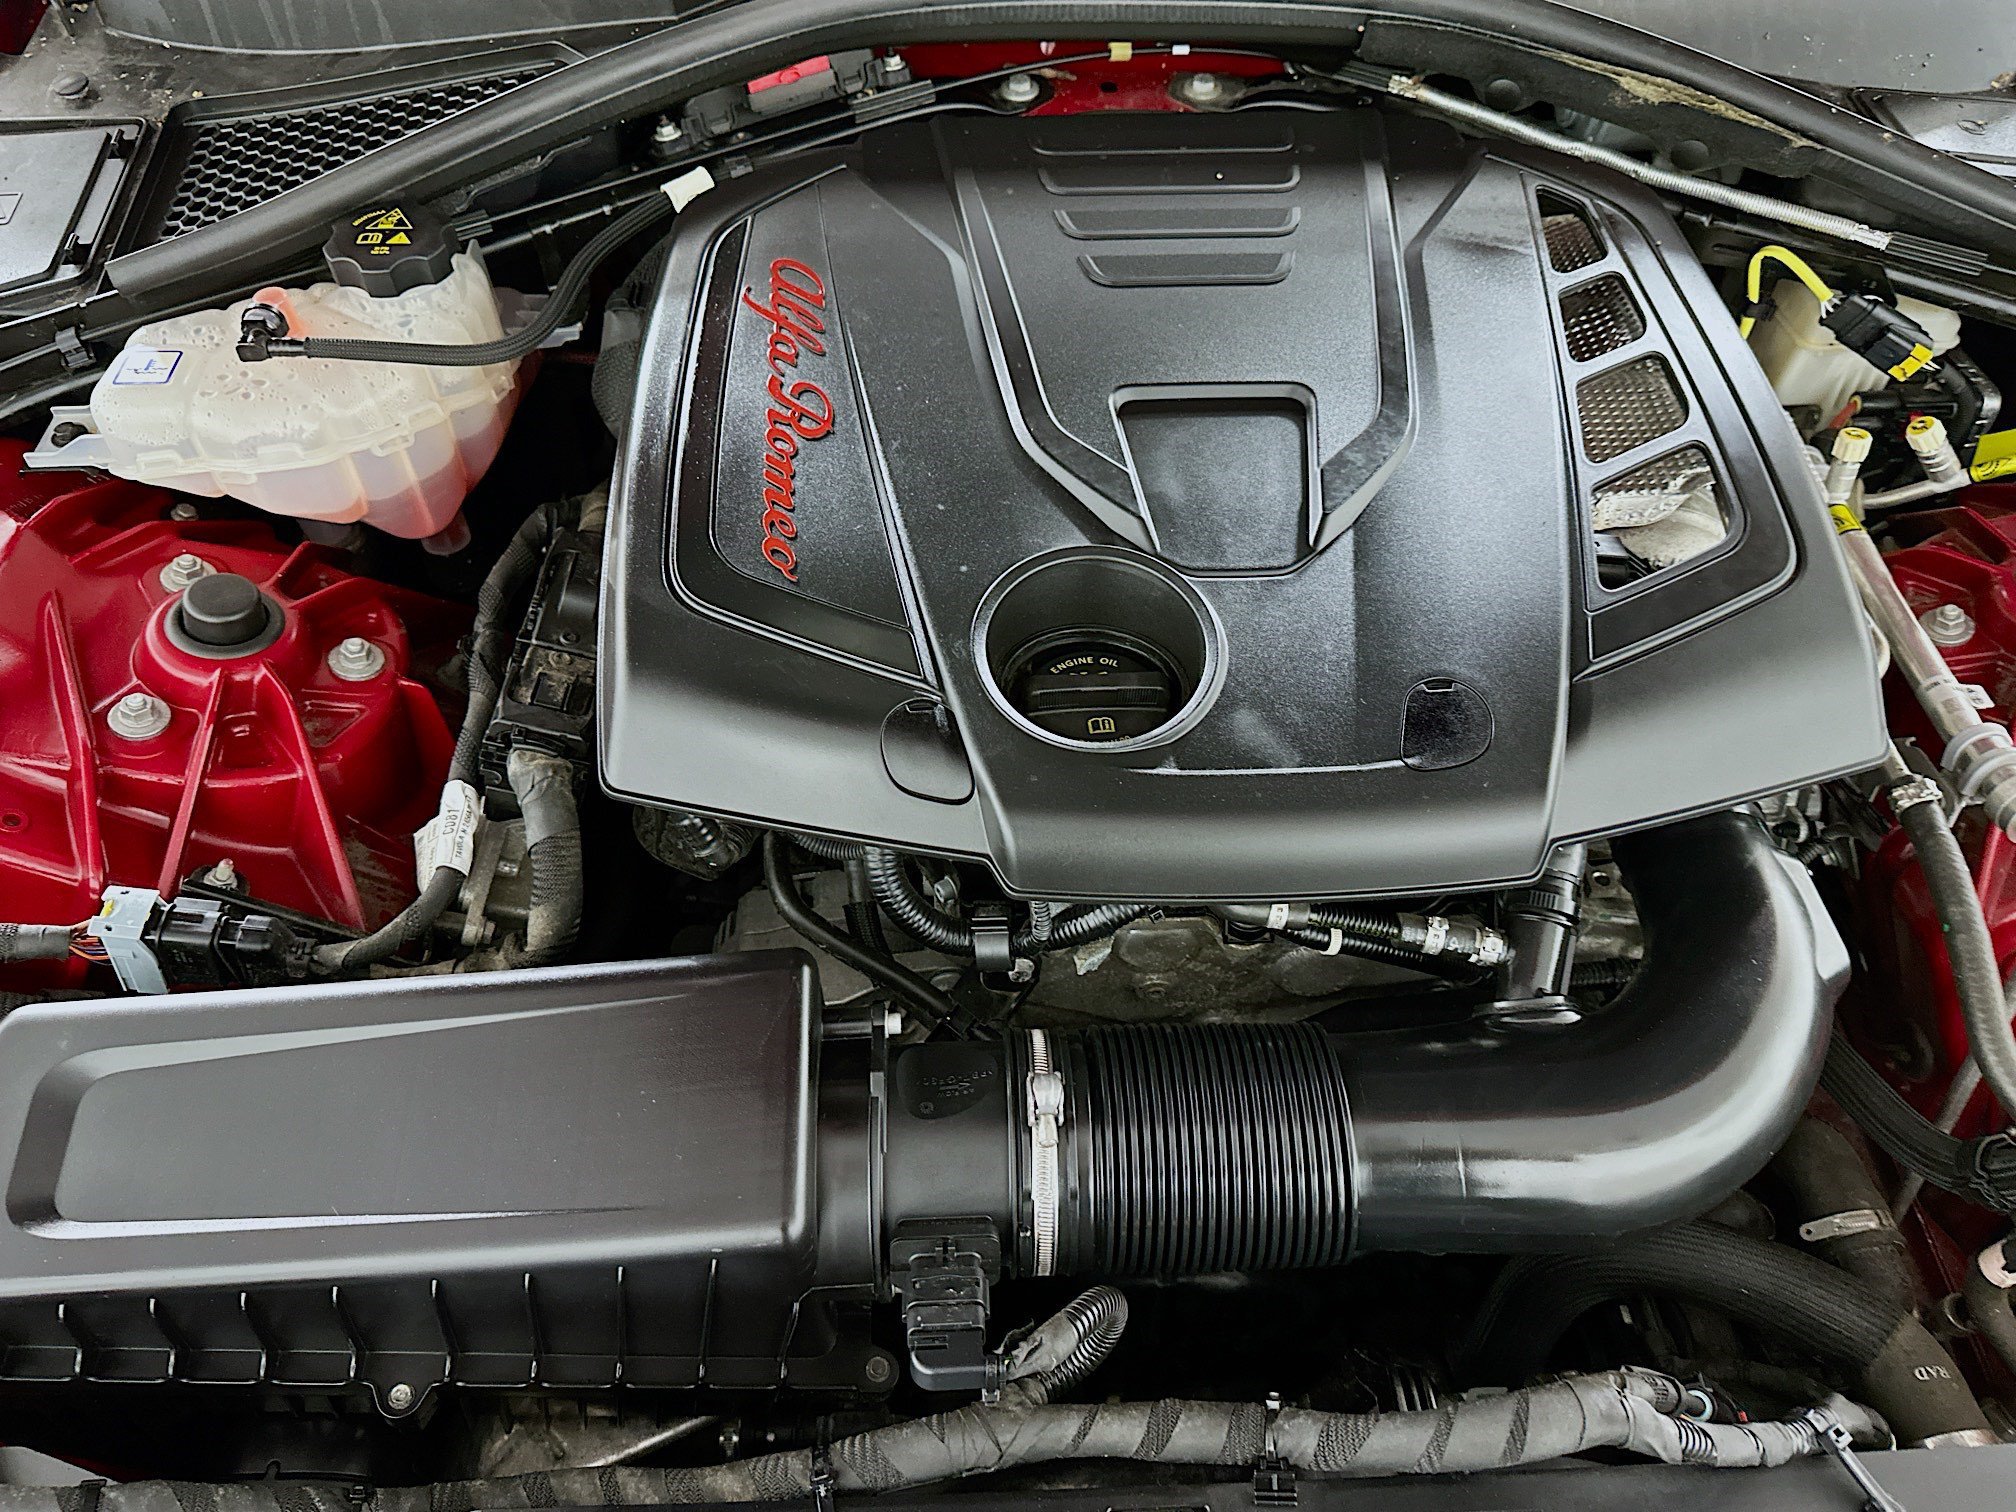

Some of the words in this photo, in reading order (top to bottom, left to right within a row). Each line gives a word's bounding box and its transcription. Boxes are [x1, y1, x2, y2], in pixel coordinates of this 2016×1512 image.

[742, 258, 826, 376] Alfa
[762, 374, 835, 582] Romeo
[1050, 656, 1094, 674] ENGINE
[1100, 657, 1119, 667] OIL
[1914, 1364, 1952, 1381] RAD
